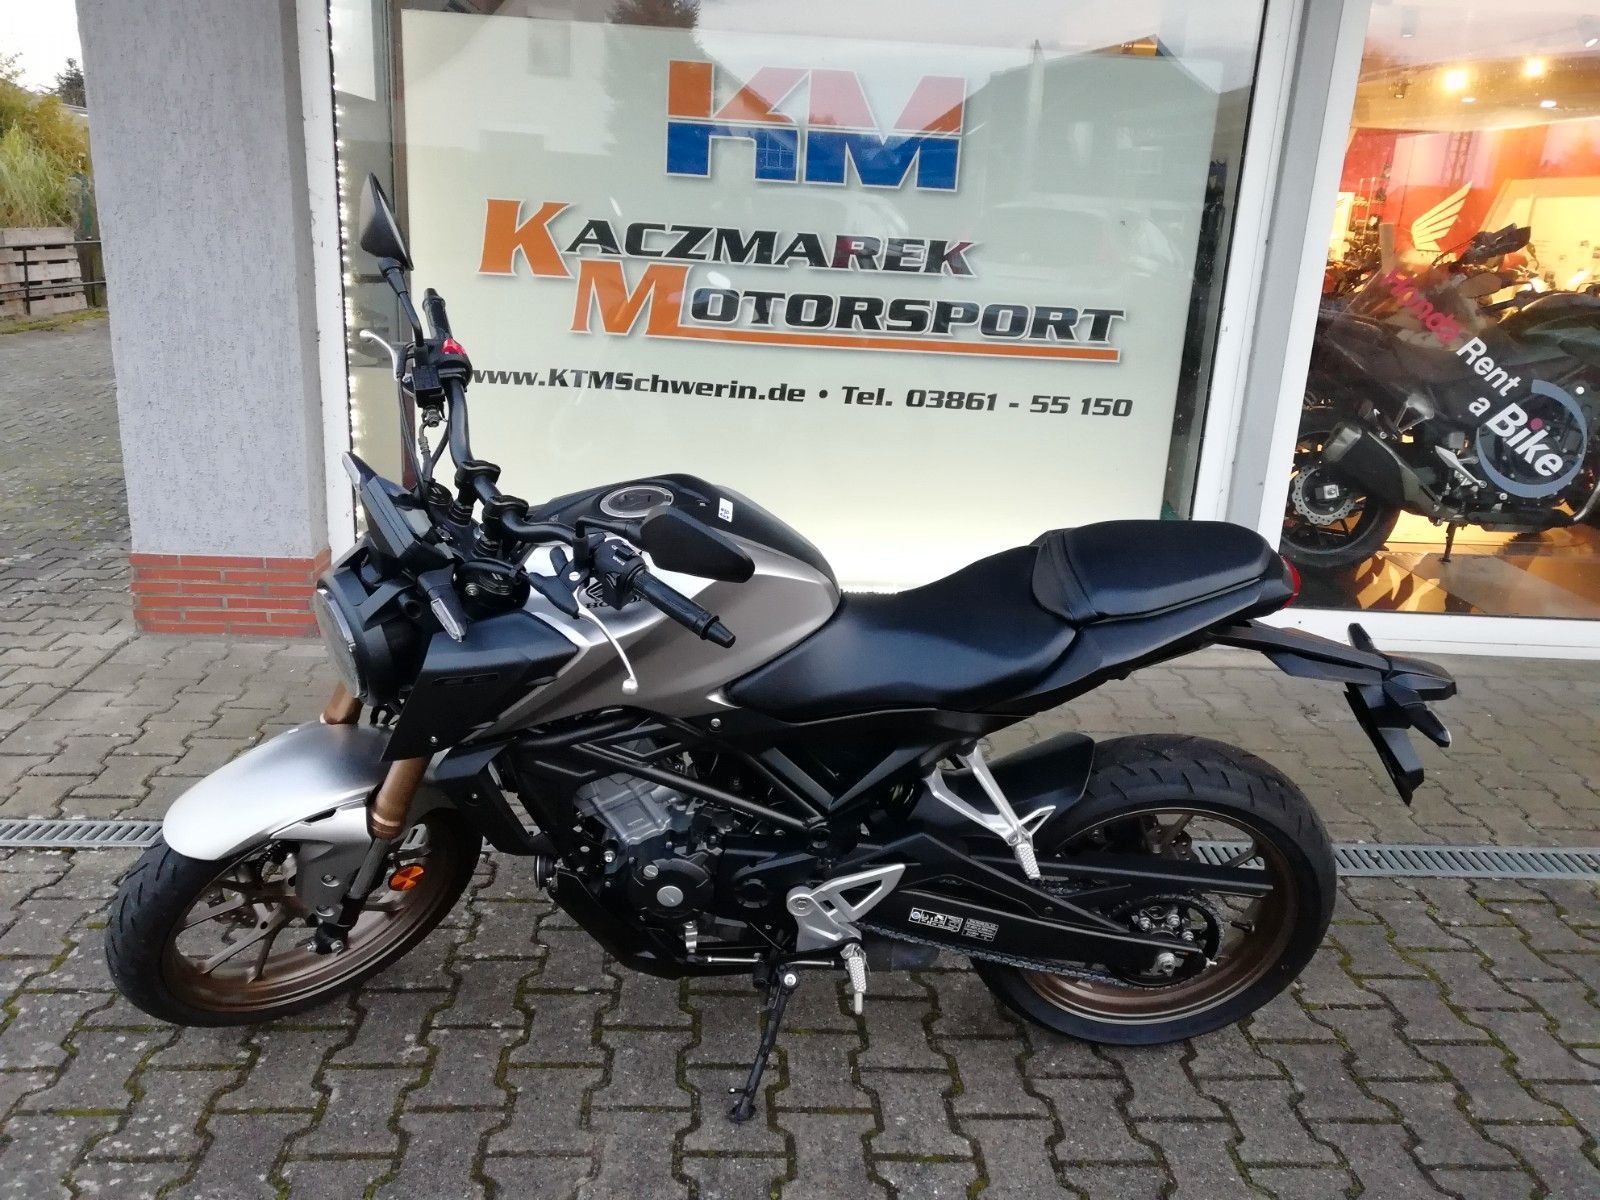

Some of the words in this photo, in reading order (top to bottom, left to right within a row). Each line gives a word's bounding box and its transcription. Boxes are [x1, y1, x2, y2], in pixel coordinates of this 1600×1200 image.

[478, 198, 976, 279] KACZMAREK
[568, 258, 1126, 345] MOTORSPORT
[841, 385, 893, 407] Tel.
[905, 388, 998, 411] 03861
[1029, 394, 1071, 414] 55
[1080, 397, 1133, 417] 150
[1455, 336, 1522, 397] Rent
[1468, 396, 1491, 418] a
[1485, 402, 1564, 477] Bike
